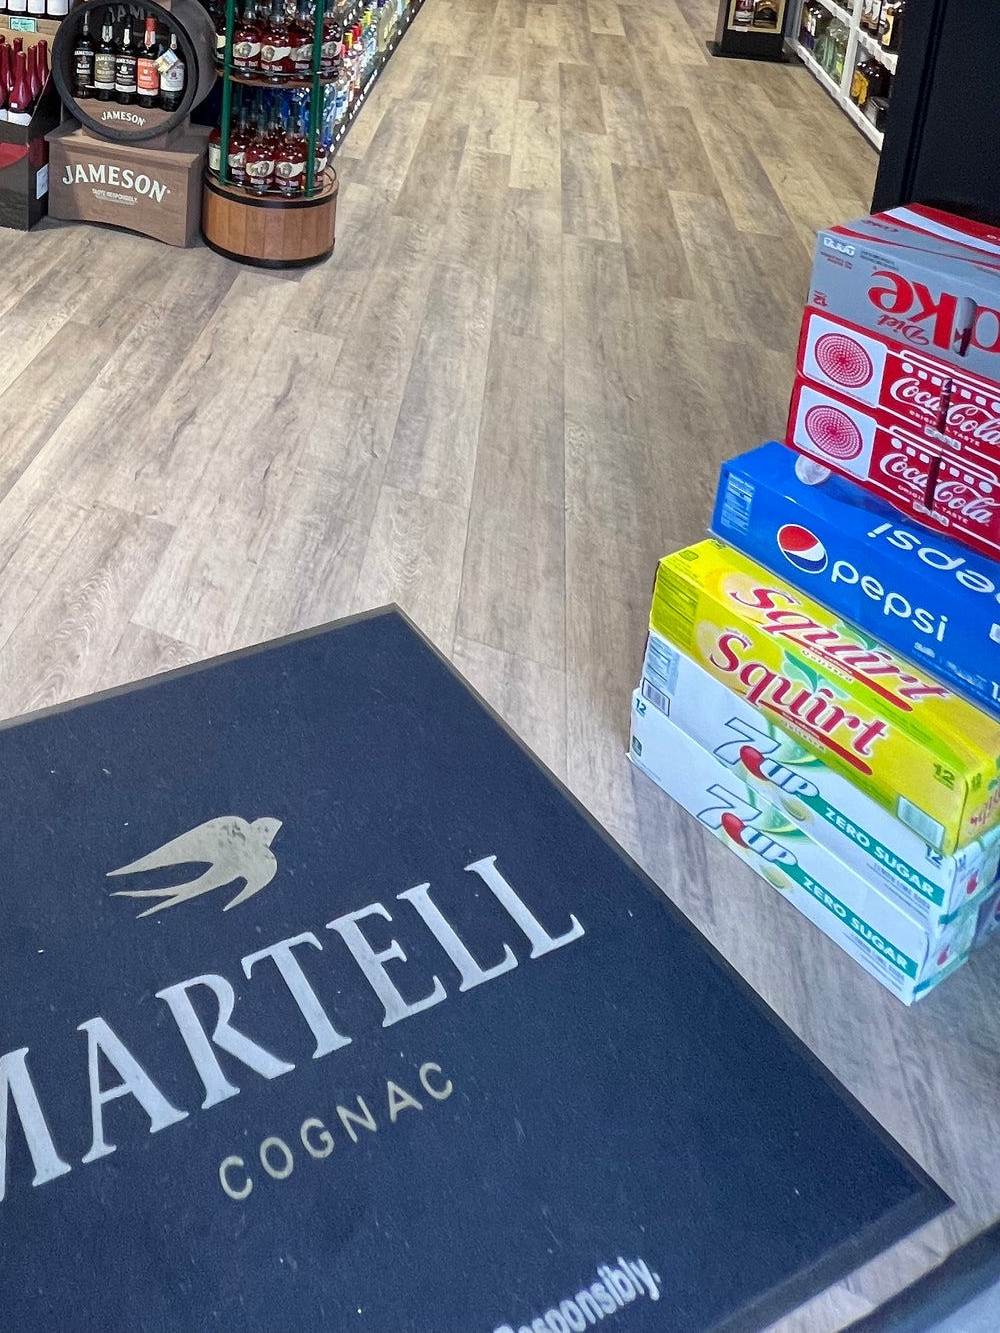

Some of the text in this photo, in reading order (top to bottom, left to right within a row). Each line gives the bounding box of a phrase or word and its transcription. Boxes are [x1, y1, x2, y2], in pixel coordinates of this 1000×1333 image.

[101, 110, 146, 127] JAMESON
[62, 163, 168, 203] JAMESON
[868, 270, 1000, 353] oke
[877, 314, 930, 346] Diet
[953, 432, 980, 447] TASTE
[941, 507, 969, 524] TASTE
[831, 561, 948, 642] pepsi
[867, 523, 1000, 604] epsi
[729, 587, 950, 700] Squirt
[635, 698, 647, 714] 12
[709, 633, 887, 756] Squirt
[713, 716, 819, 798] 7UP
[934, 763, 955, 785] 12
[696, 783, 799, 867] 7UP
[825, 807, 870, 848] ZERO
[873, 846, 934, 898] SUGAR
[802, 876, 847, 917] ZERO
[850, 917, 908, 970] SUGAR
[219, 1059, 457, 1202] COGNAC
[492, 1256, 661, 1333] ponsibly.
